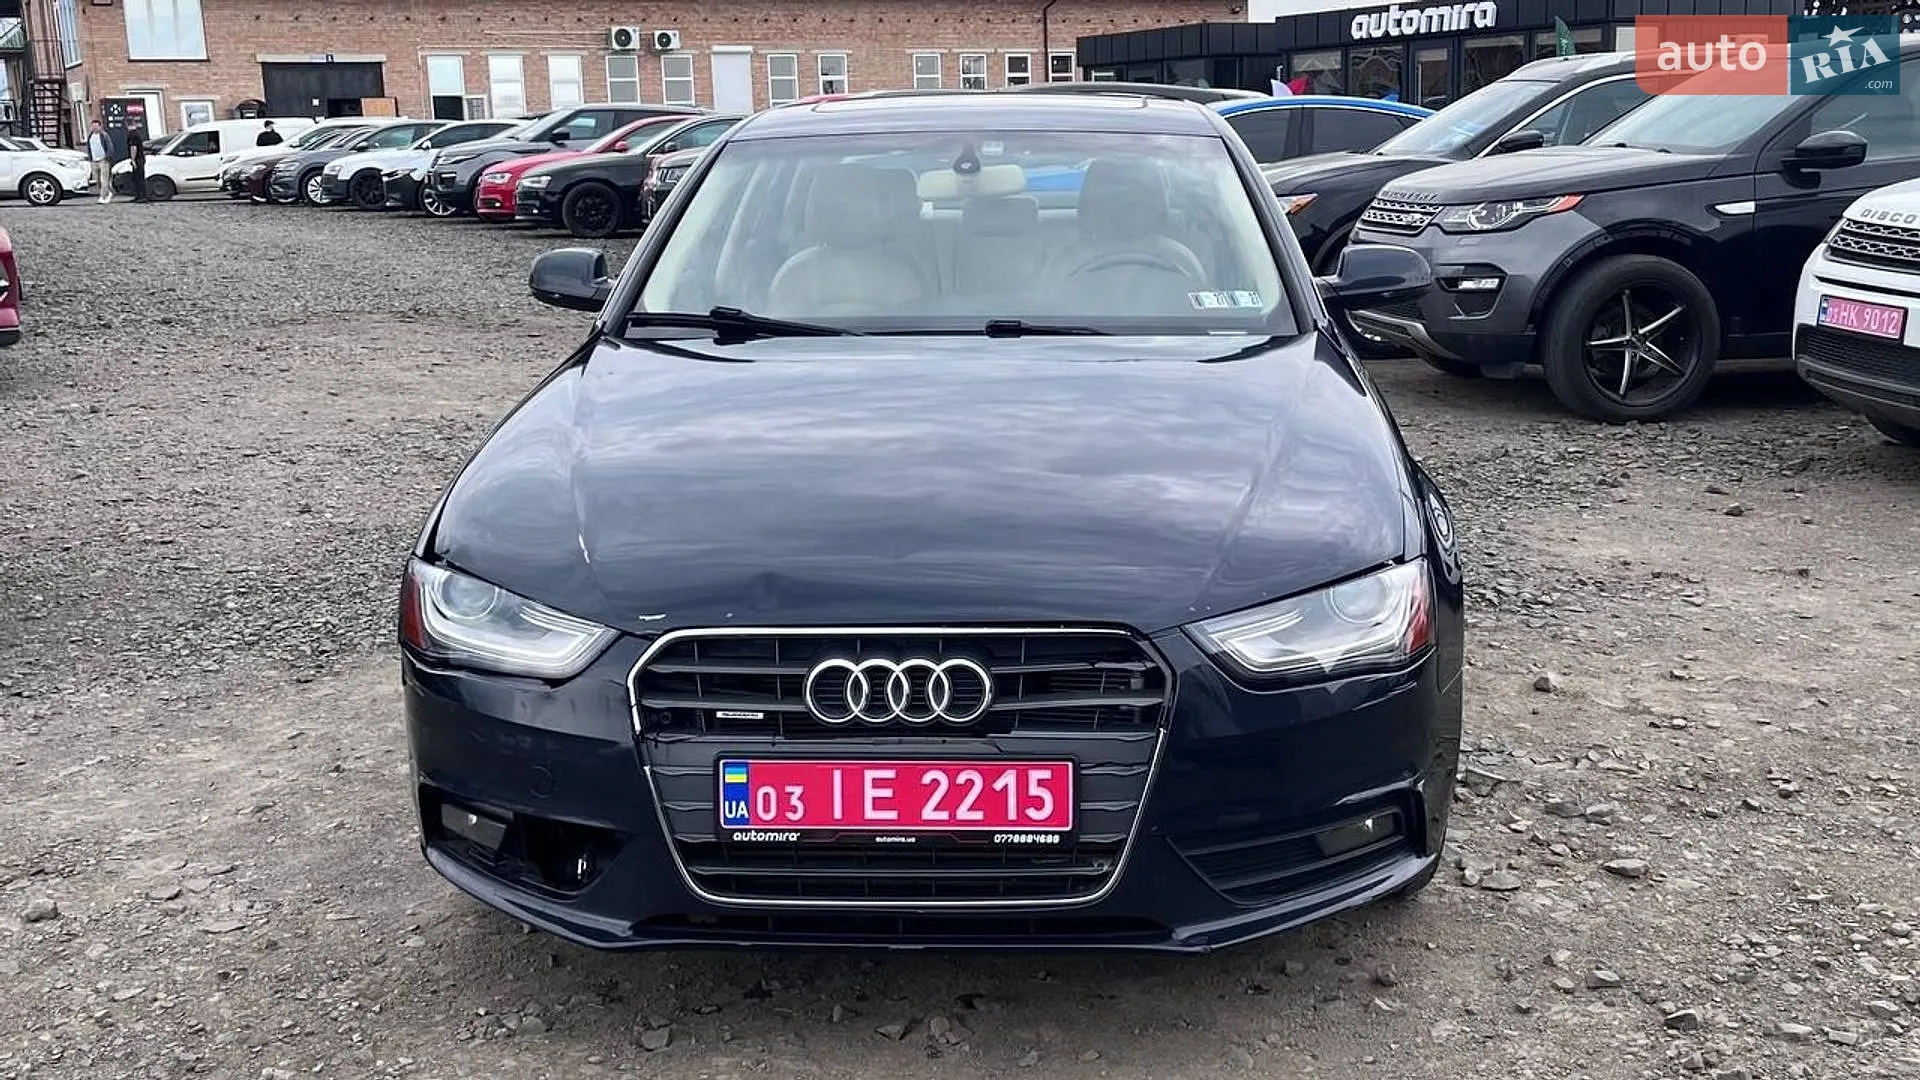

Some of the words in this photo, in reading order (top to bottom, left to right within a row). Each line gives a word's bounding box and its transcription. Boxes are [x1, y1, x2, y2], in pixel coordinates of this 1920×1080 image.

[1351, 1, 1497, 40] automira
[1864, 308, 1899, 334] 9012
[756, 785, 805, 821] 03
[833, 769, 899, 820] IE
[920, 769, 1054, 821] 2215
[724, 801, 749, 819] UA
[733, 830, 800, 842] automira
